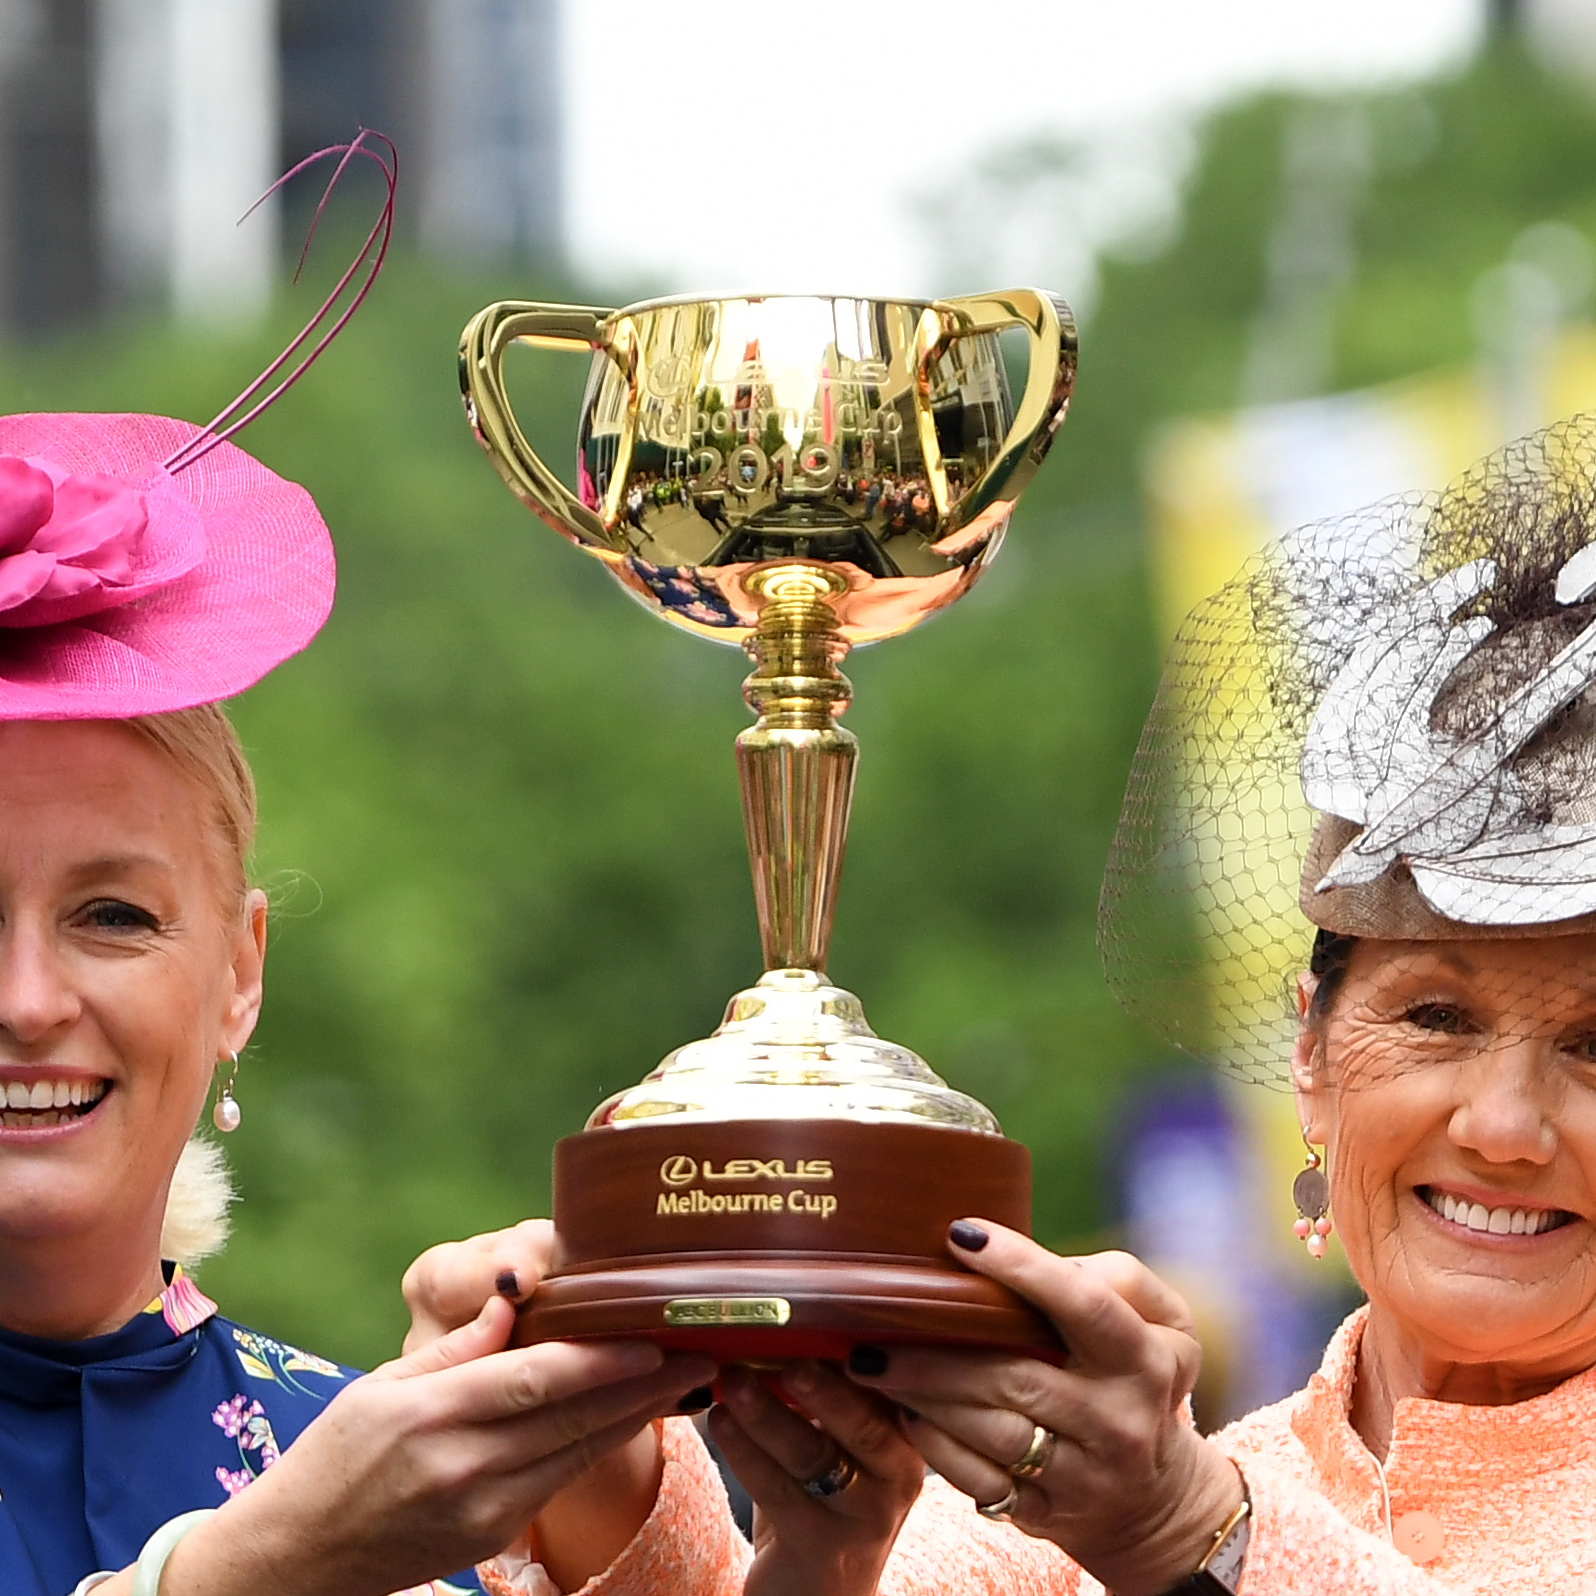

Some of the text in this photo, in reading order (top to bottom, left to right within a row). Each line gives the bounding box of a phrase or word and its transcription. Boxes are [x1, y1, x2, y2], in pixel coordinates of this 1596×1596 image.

[637, 400, 903, 444] Melbourne Cup
[689, 443, 839, 495] 2019
[703, 1159, 834, 1179] LEXUS
[656, 1189, 837, 1218] Melbourne Cup
